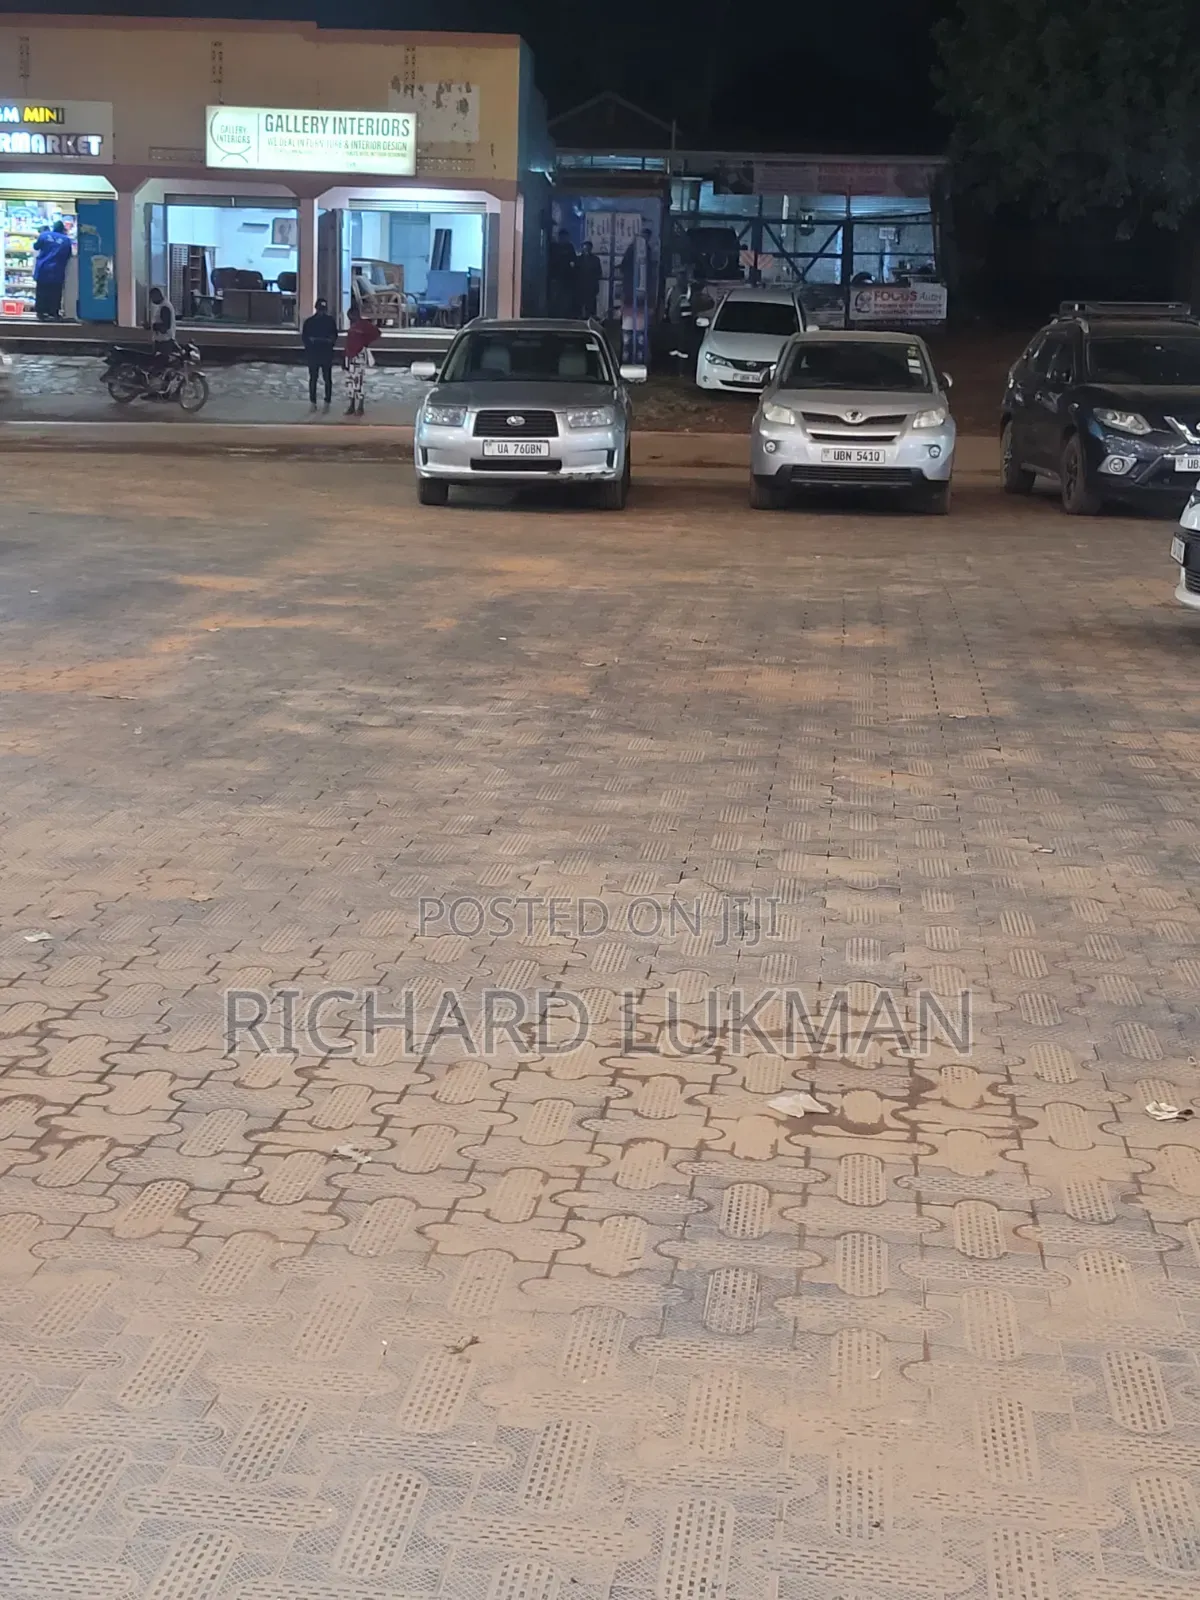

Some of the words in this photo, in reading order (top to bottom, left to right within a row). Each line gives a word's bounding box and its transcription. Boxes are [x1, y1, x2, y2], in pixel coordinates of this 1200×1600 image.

[23, 106, 65, 124] MINI
[220, 124, 247, 134] GALLERY
[265, 113, 329, 135] GALLERY
[333, 116, 410, 137] INTERIORS
[216, 134, 251, 144] INTERIORS
[267, 137, 277, 147] WE
[279, 138, 295, 148] DEAL
[297, 139, 305, 148] IN
[344, 140, 349, 149] &
[350, 140, 381, 150] INTERIOR
[382, 141, 408, 151] DESIGN
[874, 290, 918, 302] FOCUS
[497, 444, 509, 454] UA
[514, 444, 542, 455] 760BN
[833, 451, 852, 461] UBN
[1187, 459, 1200, 469] UB
